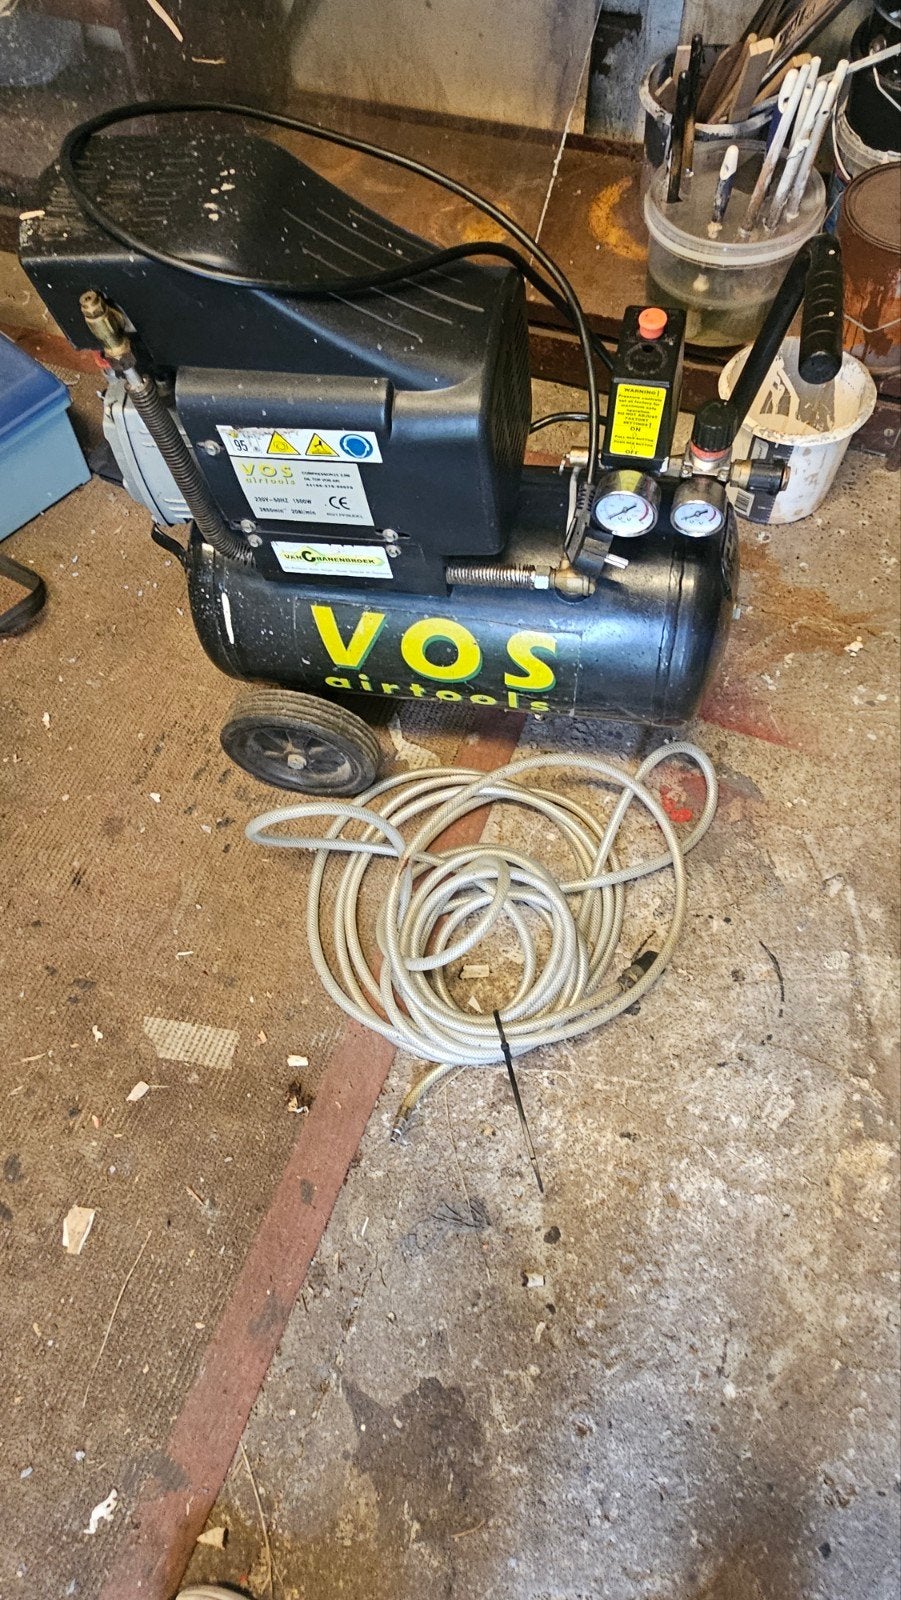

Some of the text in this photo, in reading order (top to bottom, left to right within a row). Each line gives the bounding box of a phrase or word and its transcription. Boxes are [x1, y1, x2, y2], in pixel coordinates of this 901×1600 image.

[233, 439, 248, 452] 95
[242, 463, 293, 477] VOS
[245, 477, 296, 485] airtools
[329, 496, 351, 510] CE
[310, 604, 558, 693] VOS
[324, 673, 551, 712] airtools
